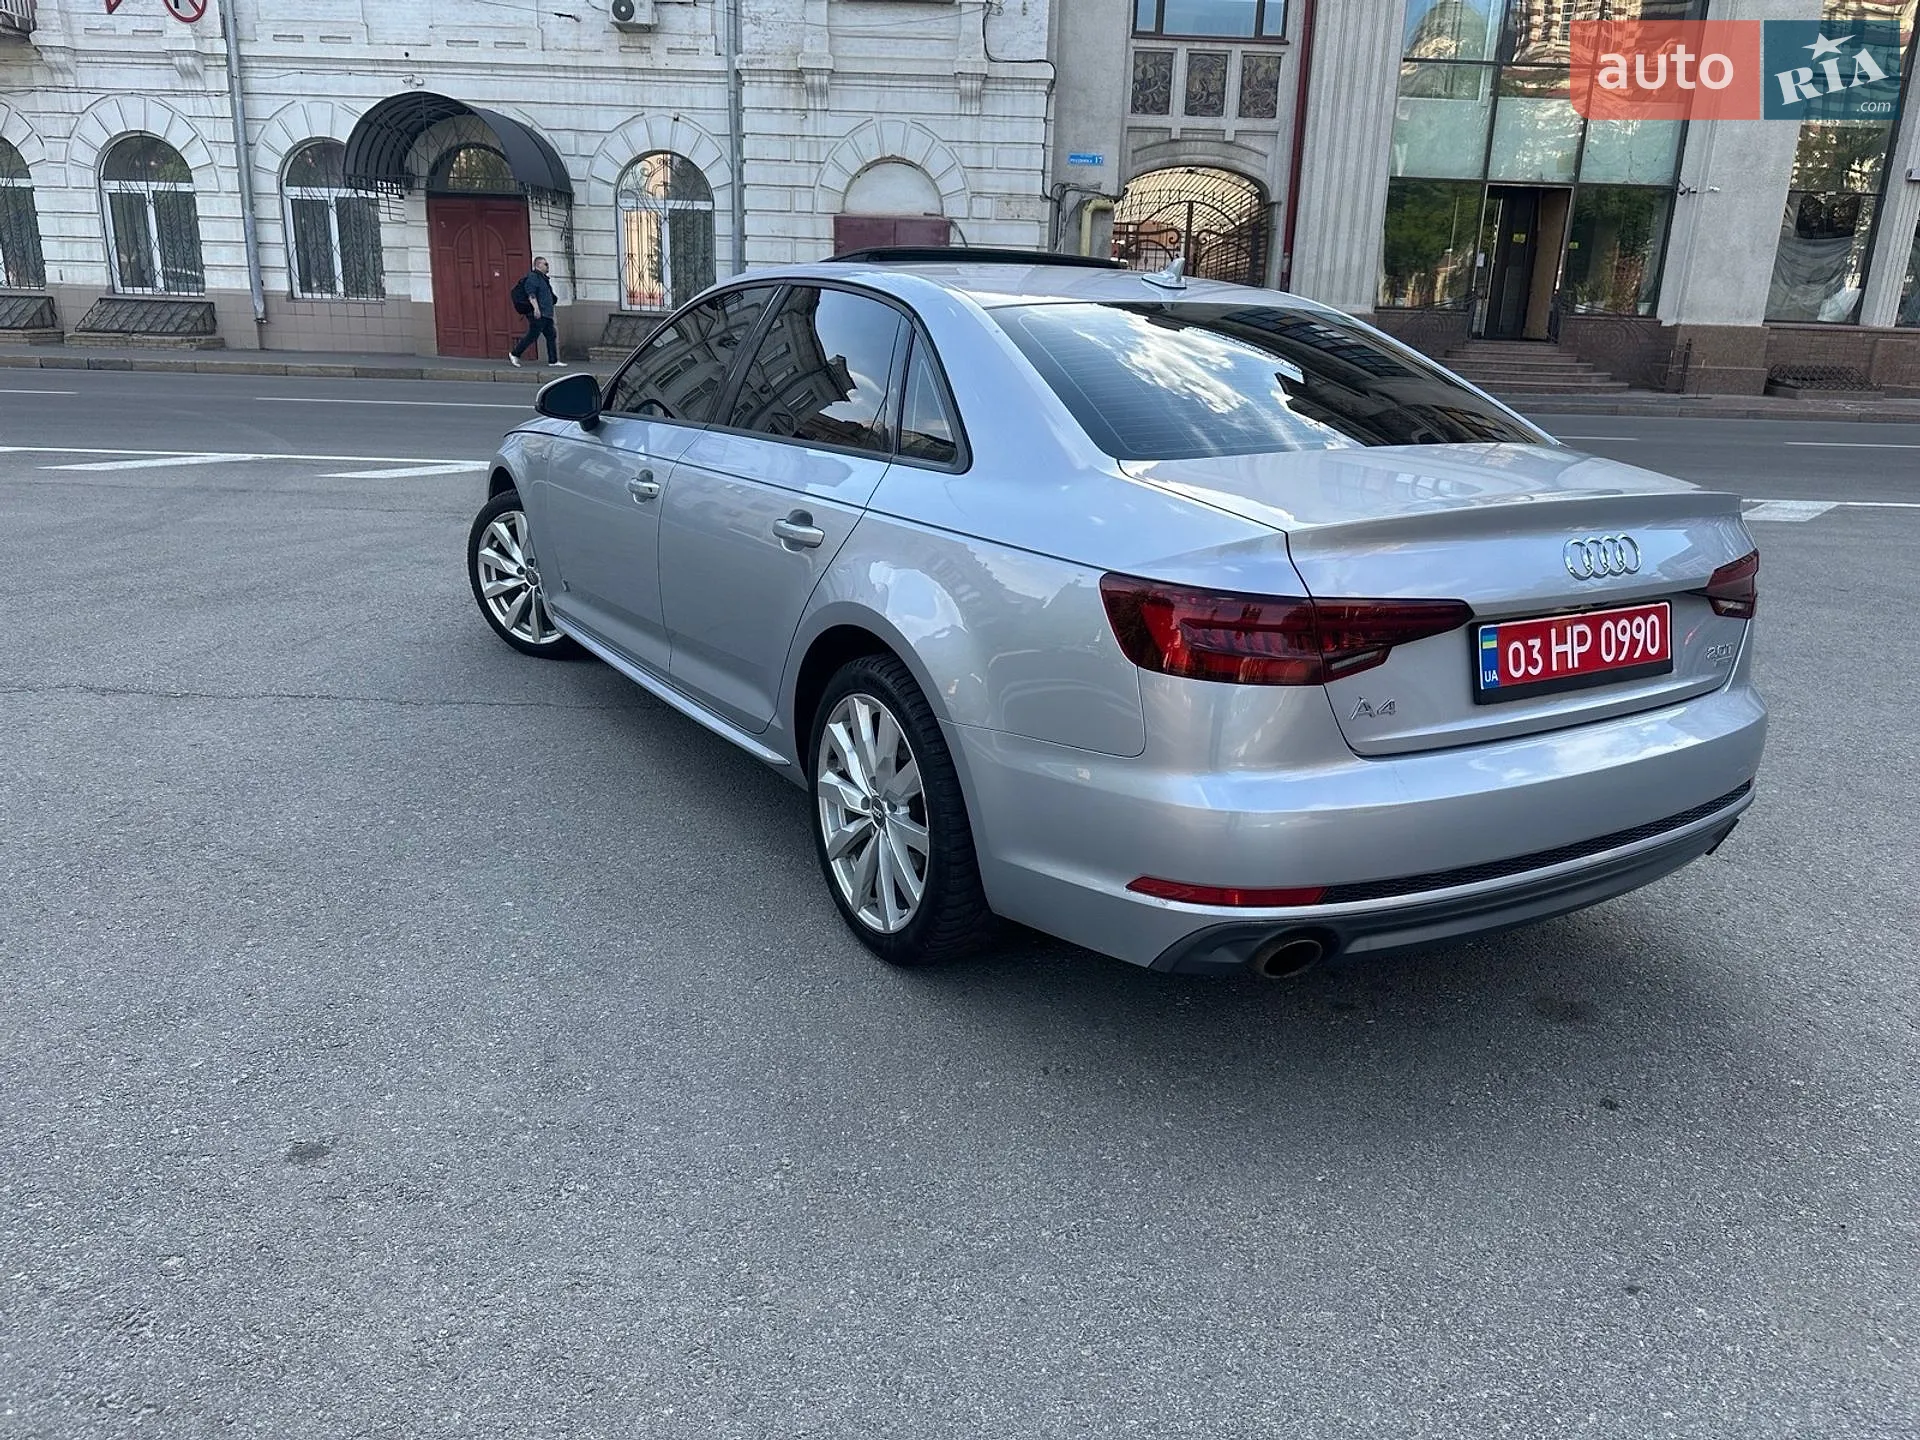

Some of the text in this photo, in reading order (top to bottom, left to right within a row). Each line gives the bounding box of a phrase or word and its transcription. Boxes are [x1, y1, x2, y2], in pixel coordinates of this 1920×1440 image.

[1508, 613, 1660, 678] 03 HP 0990
[1484, 669, 1499, 683] UA
[1350, 697, 1396, 720] A4
